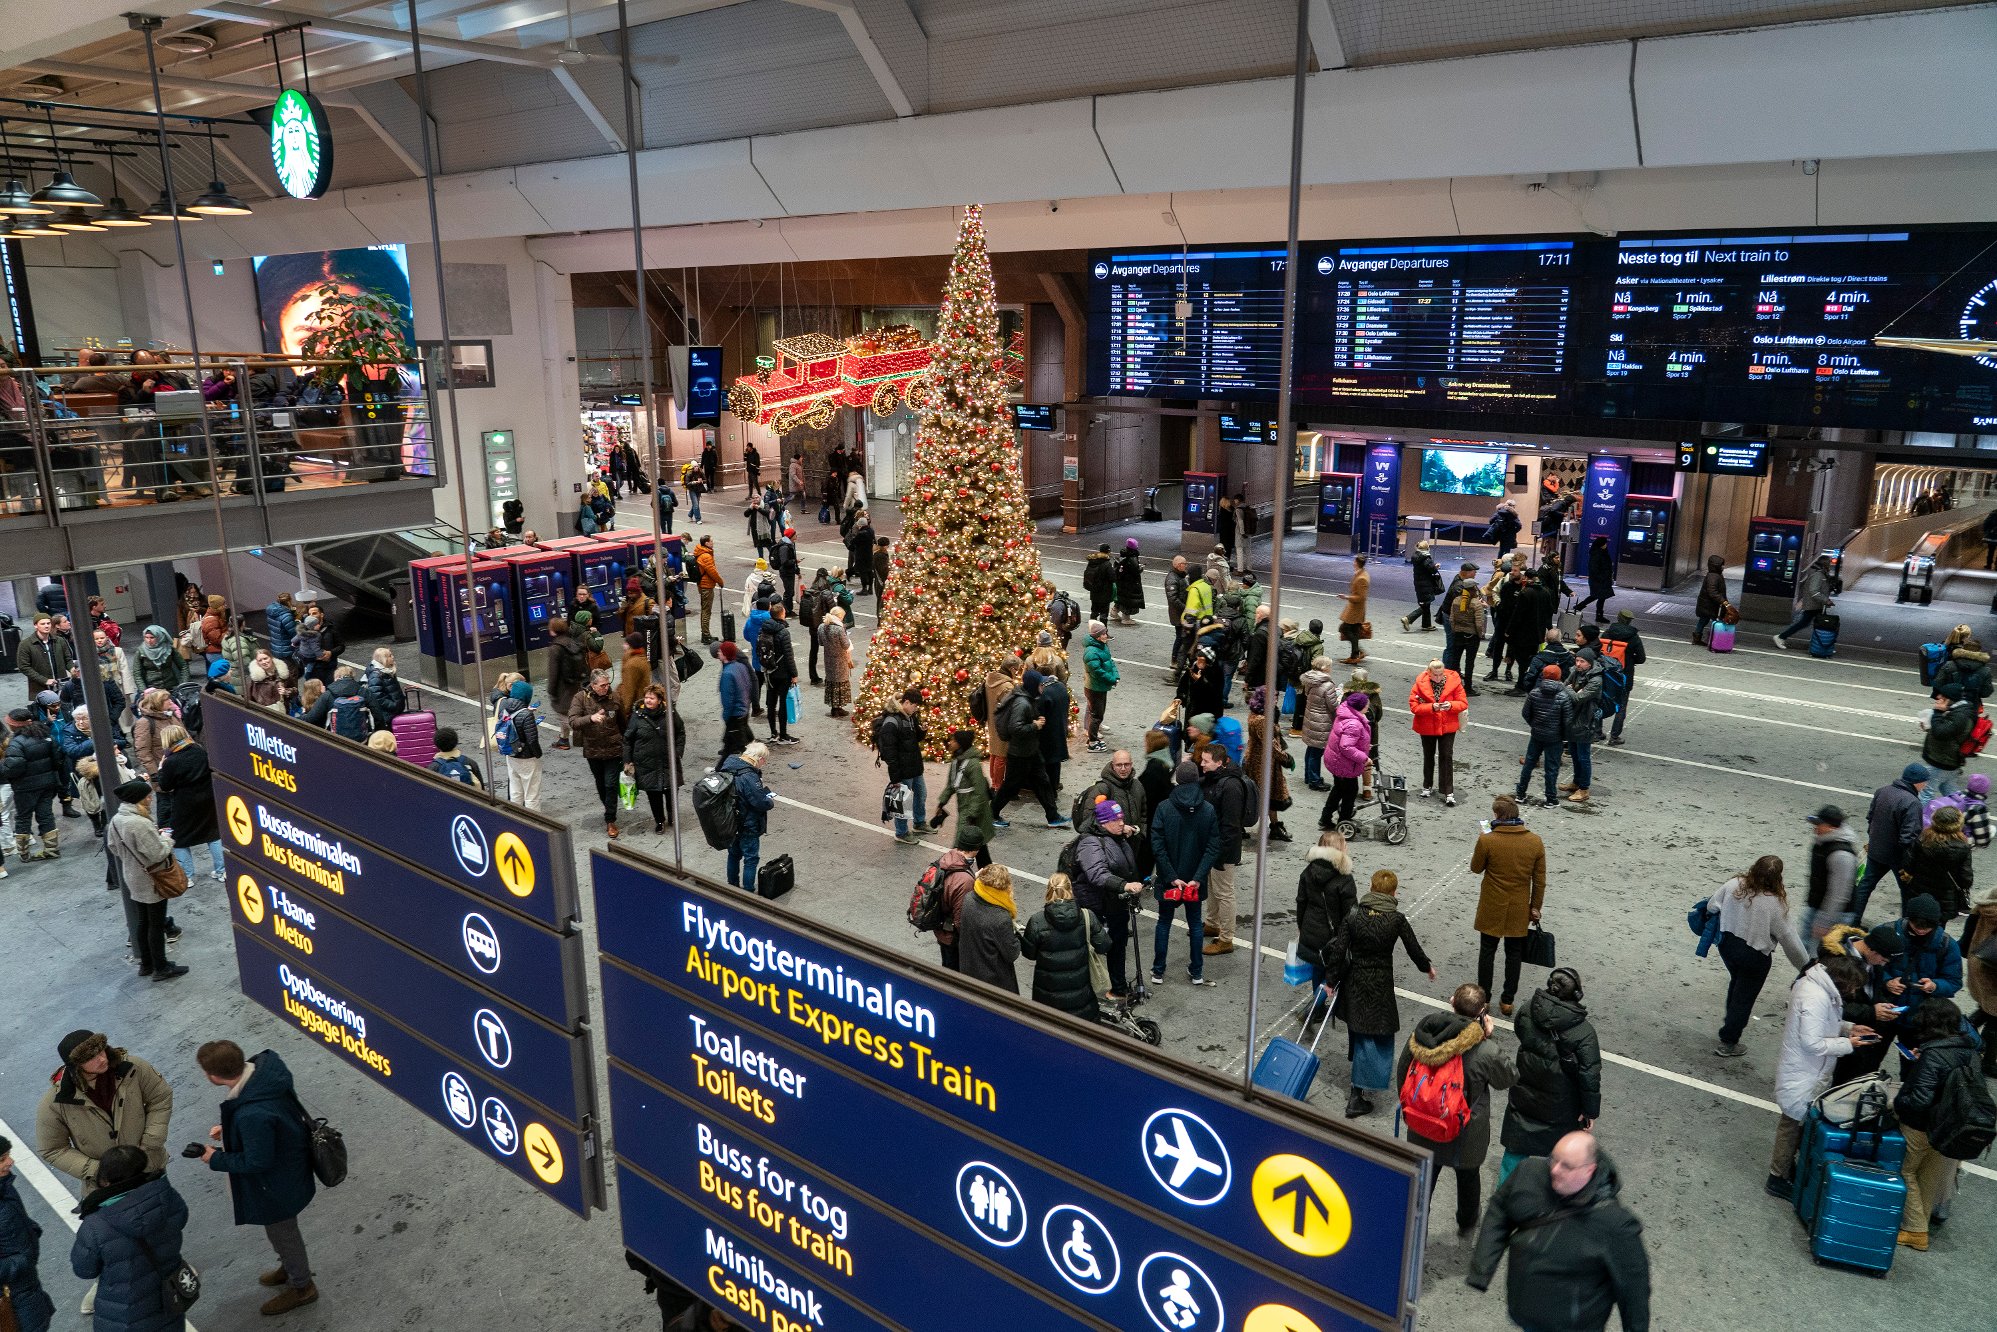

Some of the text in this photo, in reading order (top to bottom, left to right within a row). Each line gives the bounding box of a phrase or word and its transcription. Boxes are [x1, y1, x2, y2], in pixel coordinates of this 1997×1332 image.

[1538, 253, 1571, 267] 17:11
[1618, 250, 1699, 266] Neste tog til
[1704, 250, 1789, 263] Next train to
[1112, 262, 1200, 277] Avganger Departures
[1270, 261, 1288, 271] 17:1
[1339, 257, 1449, 272] Avganger Departures
[1615, 276, 1640, 284] Asker
[1700, 277, 1724, 285] Lysaker
[1760, 274, 1806, 283] Lillestrøm
[1830, 276, 1841, 284] tog
[1614, 291, 1631, 303] Nå
[1675, 291, 1713, 303] 1 min.
[1759, 290, 1778, 303] Nå
[1826, 291, 1870, 303] 4 min.
[1627, 305, 1659, 313] Kongsberg
[10, 297, 26, 353] COFFEE
[1609, 333, 1623, 342] Ski
[1753, 336, 1774, 344] Oslo
[1774, 336, 1814, 345] Lufthavn
[1842, 338, 1867, 346] Airport
[1608, 350, 1625, 361] Nå
[1668, 351, 1706, 363] 4 min.
[1751, 353, 1791, 365] 1 min.
[1818, 354, 1861, 367] 8 min.
[1849, 368, 1879, 376] Lufthavn
[1270, 430, 1277, 441] 8
[1375, 461, 1390, 471] VY
[1681, 454, 1691, 466] 9
[1598, 476, 1616, 487] VY
[246, 723, 297, 764] Billetter
[249, 752, 297, 794] Tickets
[257, 804, 362, 877] Bussterminalen
[261, 833, 345, 896] Bus terminal
[268, 885, 316, 931] T-bane
[273, 914, 313, 956] Metro
[683, 901, 937, 1038] Flytogterminalen
[279, 963, 367, 1039] Oppbevaring
[283, 989, 392, 1077] Luggage lockers
[685, 945, 997, 1112] Airport Express Train
[689, 1014, 808, 1100] Toaletter
[691, 1053, 774, 1125] Toilets
[697, 1122, 849, 1241] Buss for tog
[699, 1160, 854, 1277] Bus for train
[705, 1227, 825, 1327] Minibank
[708, 1265, 767, 1324] Cash
